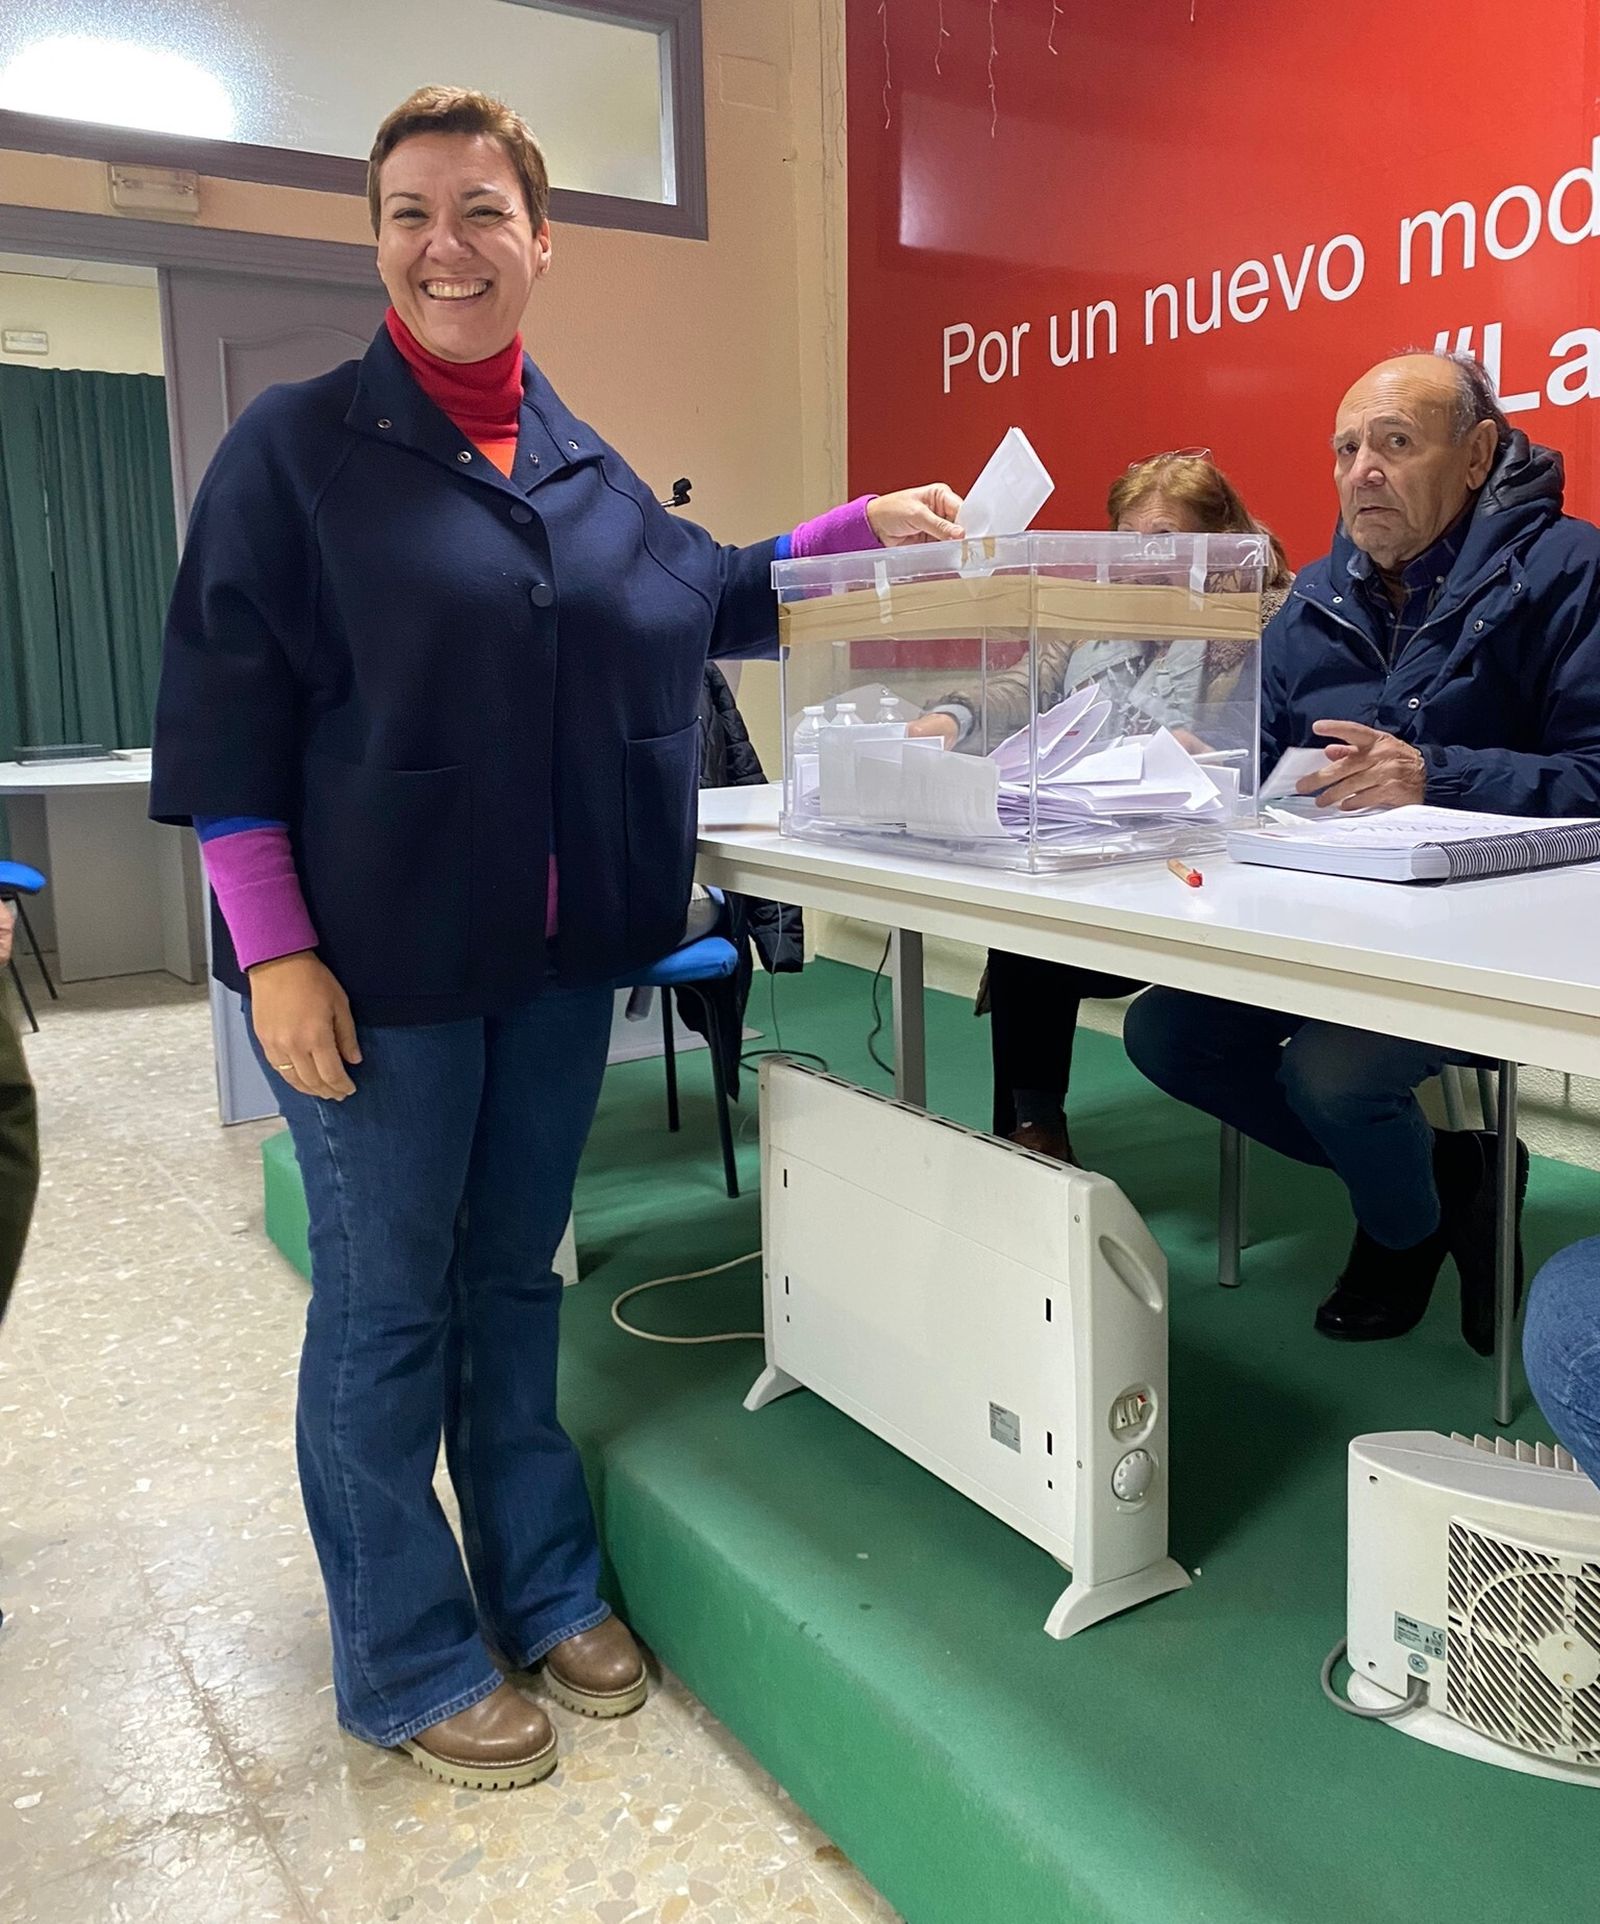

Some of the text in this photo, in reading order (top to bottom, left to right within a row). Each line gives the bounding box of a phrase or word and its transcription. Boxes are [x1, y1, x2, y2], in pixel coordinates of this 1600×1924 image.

[943, 135, 1600, 394] Por un nuevo mod
